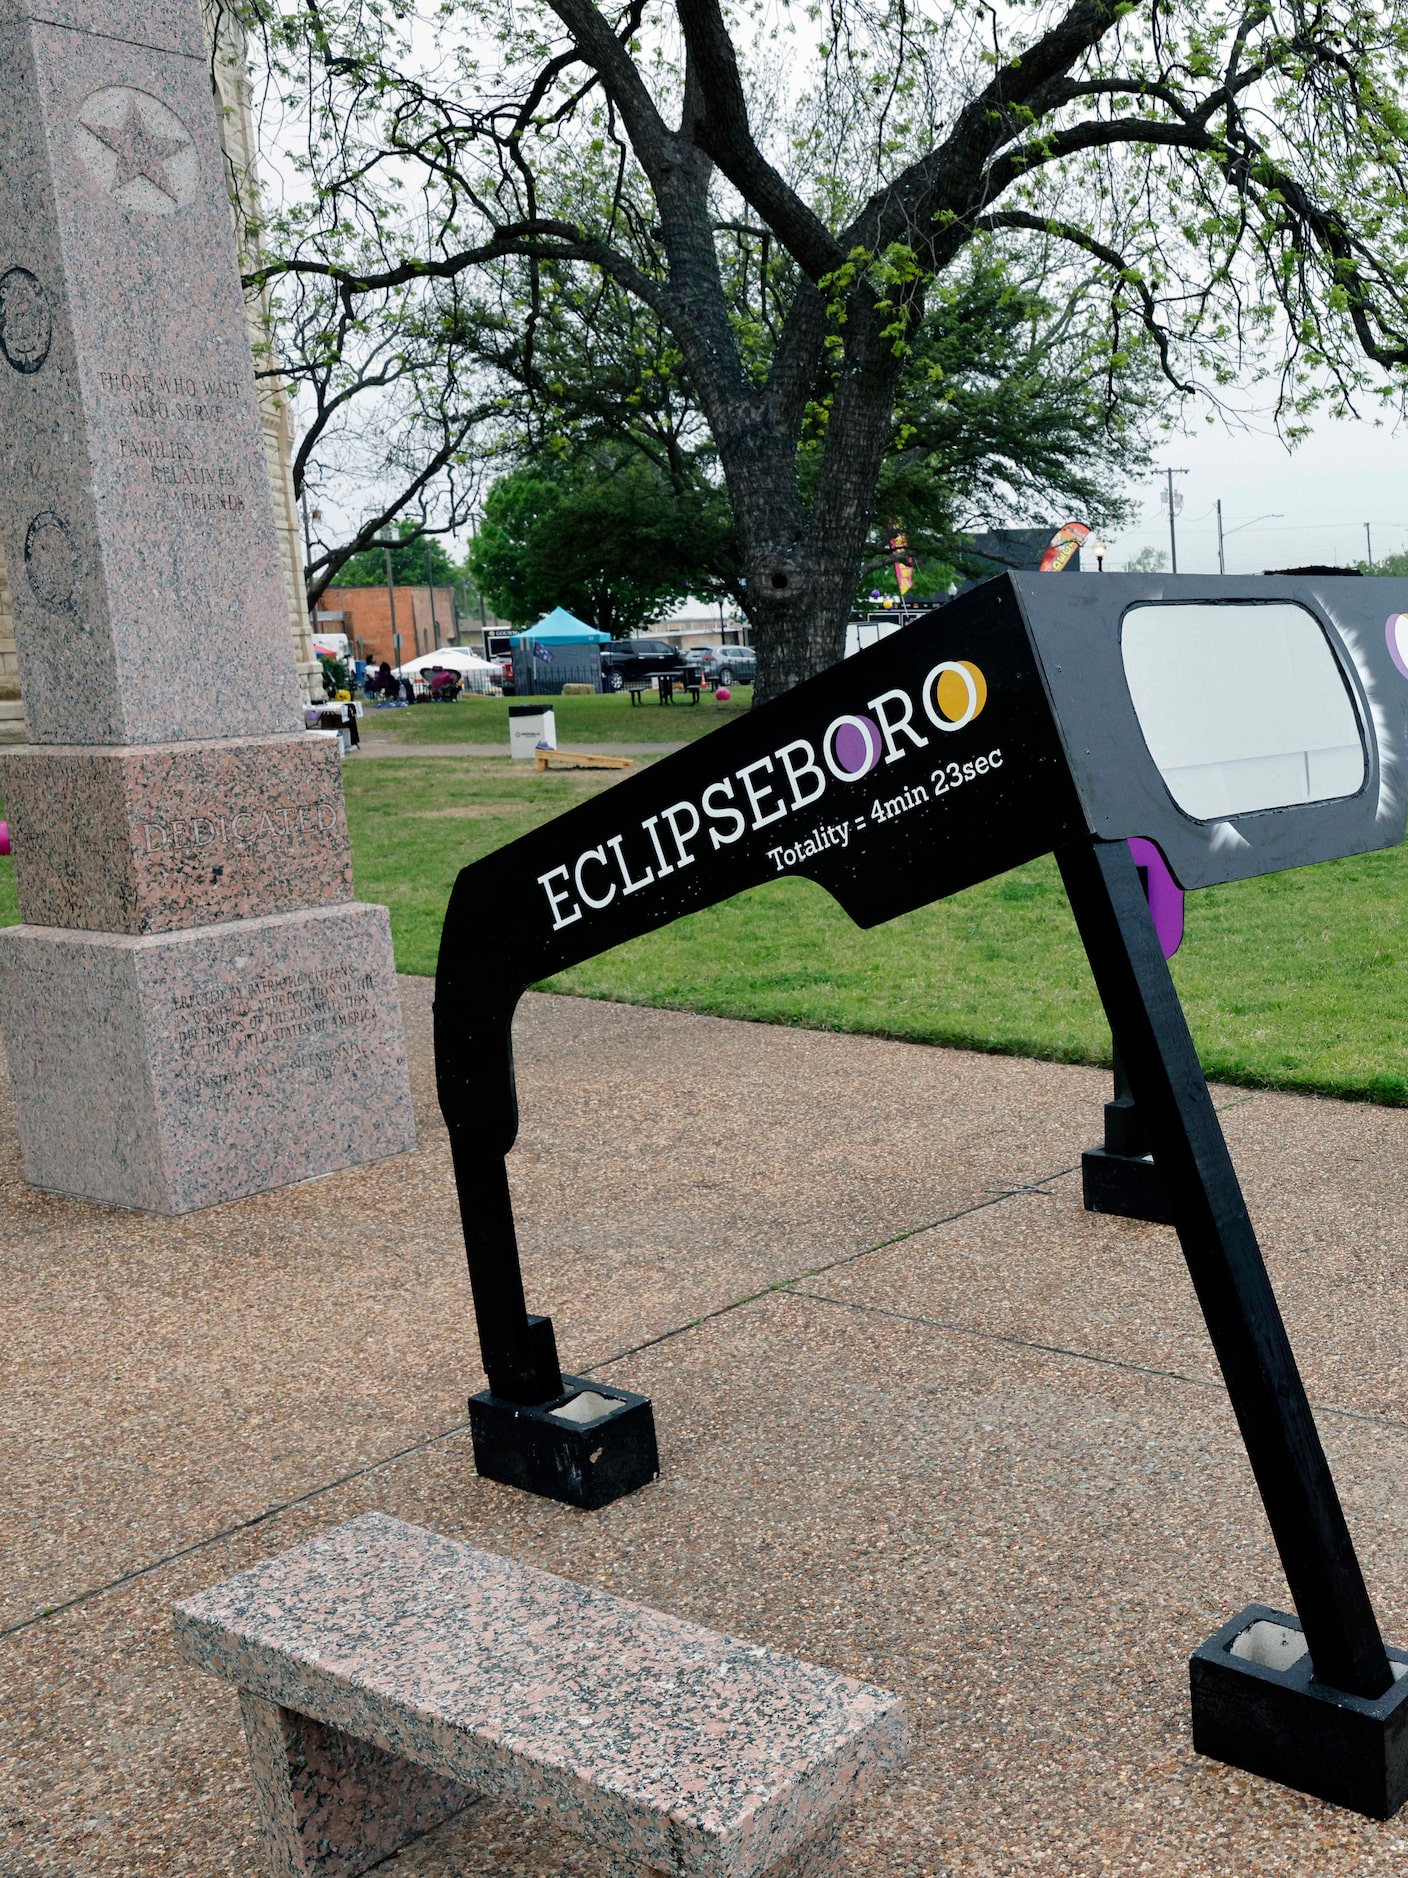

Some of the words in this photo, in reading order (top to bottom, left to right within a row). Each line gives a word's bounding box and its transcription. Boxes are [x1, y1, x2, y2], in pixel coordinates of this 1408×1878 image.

[99, 372, 151, 393] THOSE
[158, 376, 196, 397] WHO
[202, 381, 242, 400] WAIT
[128, 401, 169, 421] ALSO
[176, 402, 225, 423] SERVE
[119, 439, 195, 460] FAMILIES
[151, 466, 236, 486] RELATIVES
[183, 492, 246, 512] FRIENDS
[537, 660, 979, 932] ECLIPSEBORO
[768, 819, 853, 874] Totality
[853, 814, 868, 832] =
[869, 782, 931, 827] 4min
[929, 748, 1005, 796] 23sec
[143, 804, 338, 852] DEDICATED
